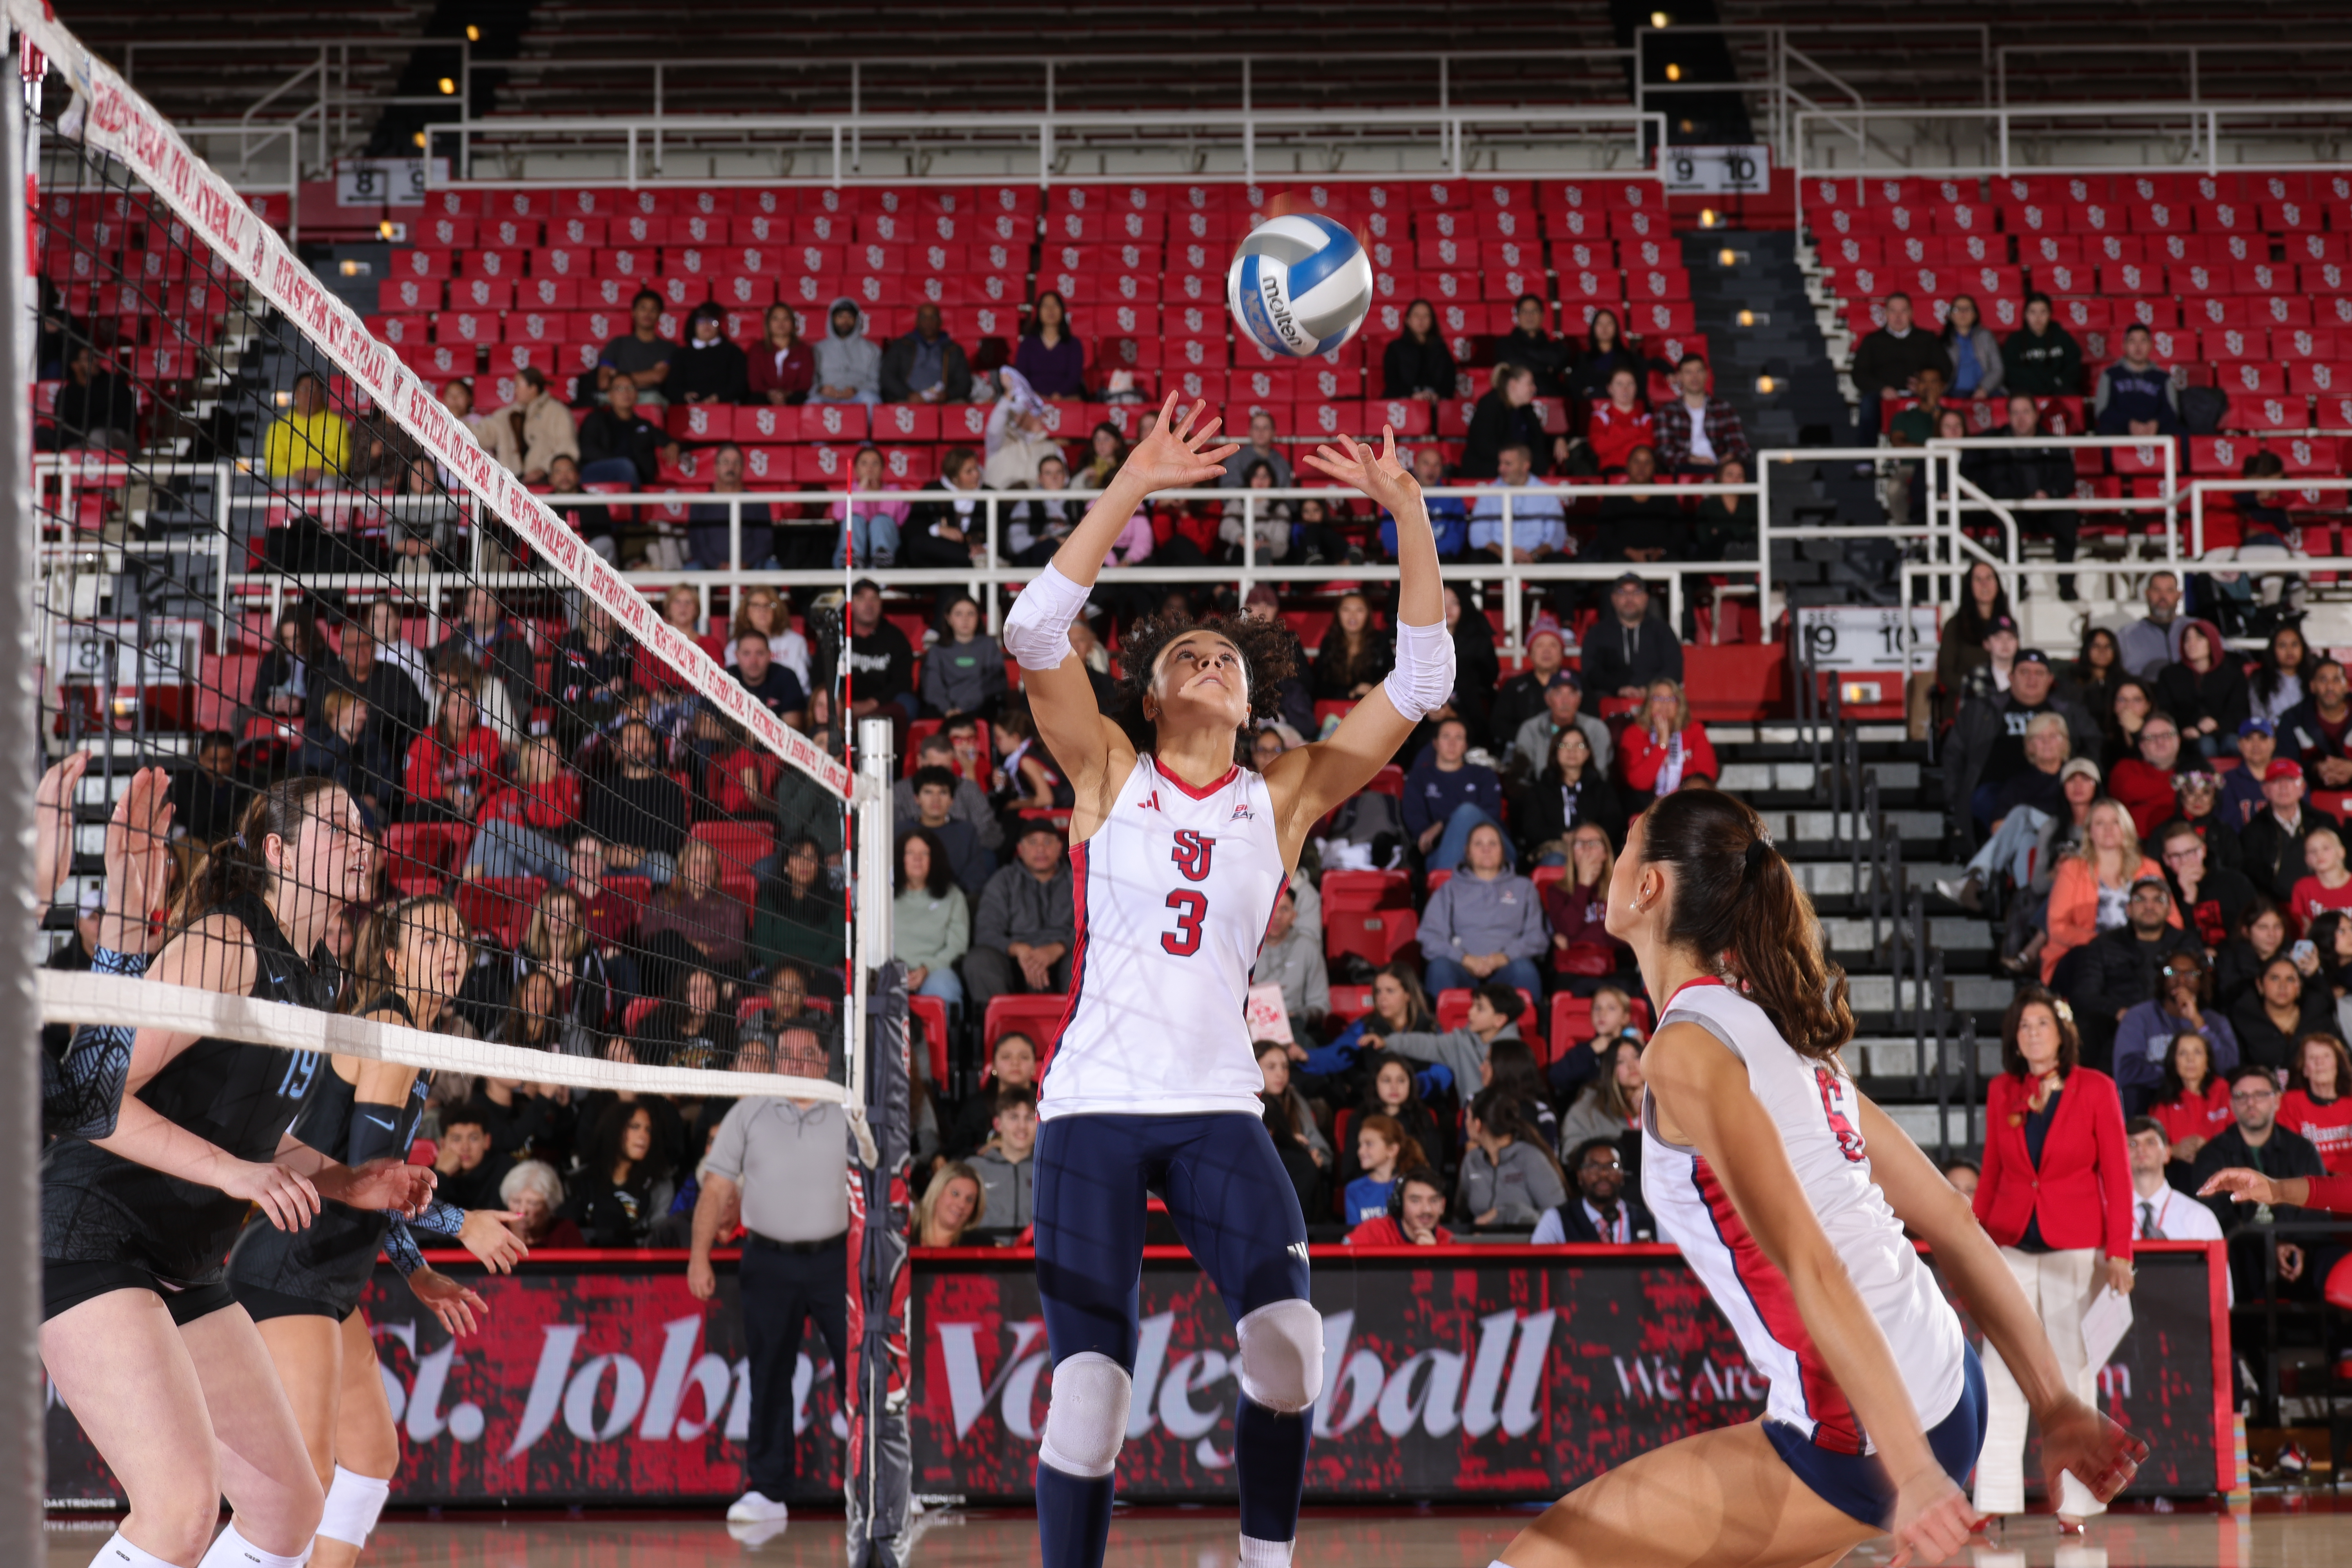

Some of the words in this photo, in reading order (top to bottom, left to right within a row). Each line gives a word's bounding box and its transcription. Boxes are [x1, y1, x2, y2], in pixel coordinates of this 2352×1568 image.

[1263, 275, 1303, 346] molten
[1160, 887, 1209, 957] 3
[276, 1048, 320, 1100] 19
[1814, 1066, 1866, 1163] 6
[936, 1308, 1556, 1469] Voleball
[1612, 1355, 1682, 1401] We
[43, 1498, 117, 1508] DAKTRONICS
[915, 1494, 967, 1504] TRONICS
